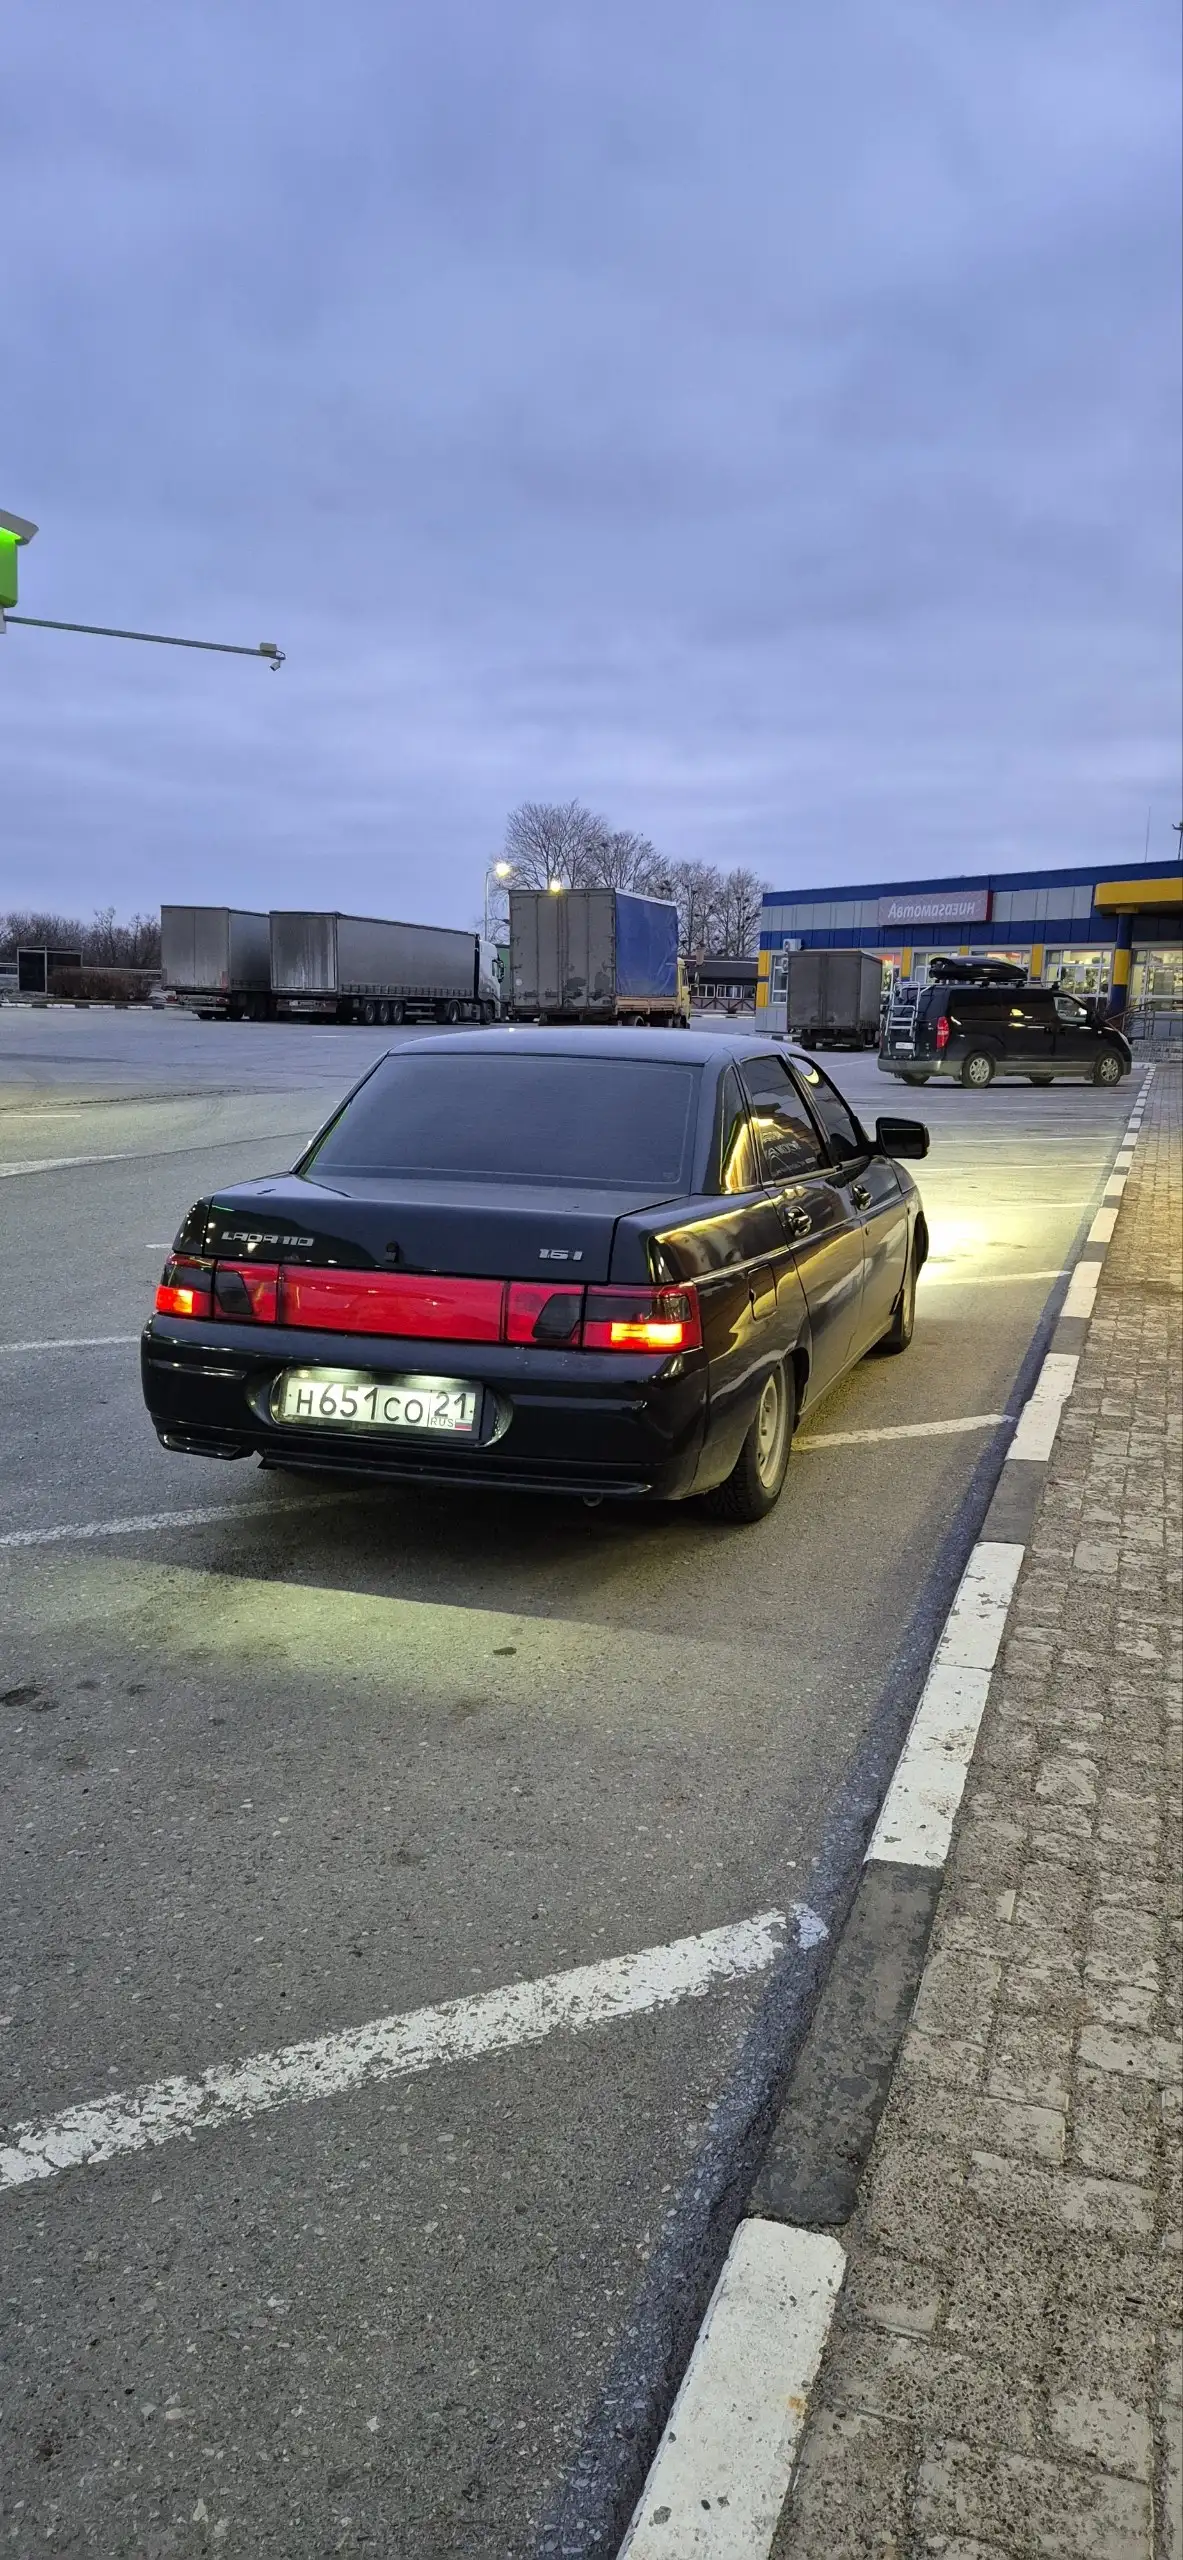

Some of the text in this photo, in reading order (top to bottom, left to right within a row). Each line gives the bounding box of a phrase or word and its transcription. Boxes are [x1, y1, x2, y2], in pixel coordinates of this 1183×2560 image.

[887, 902, 976, 918] Автомагазин
[221, 1231, 314, 1247] LADA 110
[433, 1390, 467, 1420] 21
[430, 1416, 455, 1428] RUS
